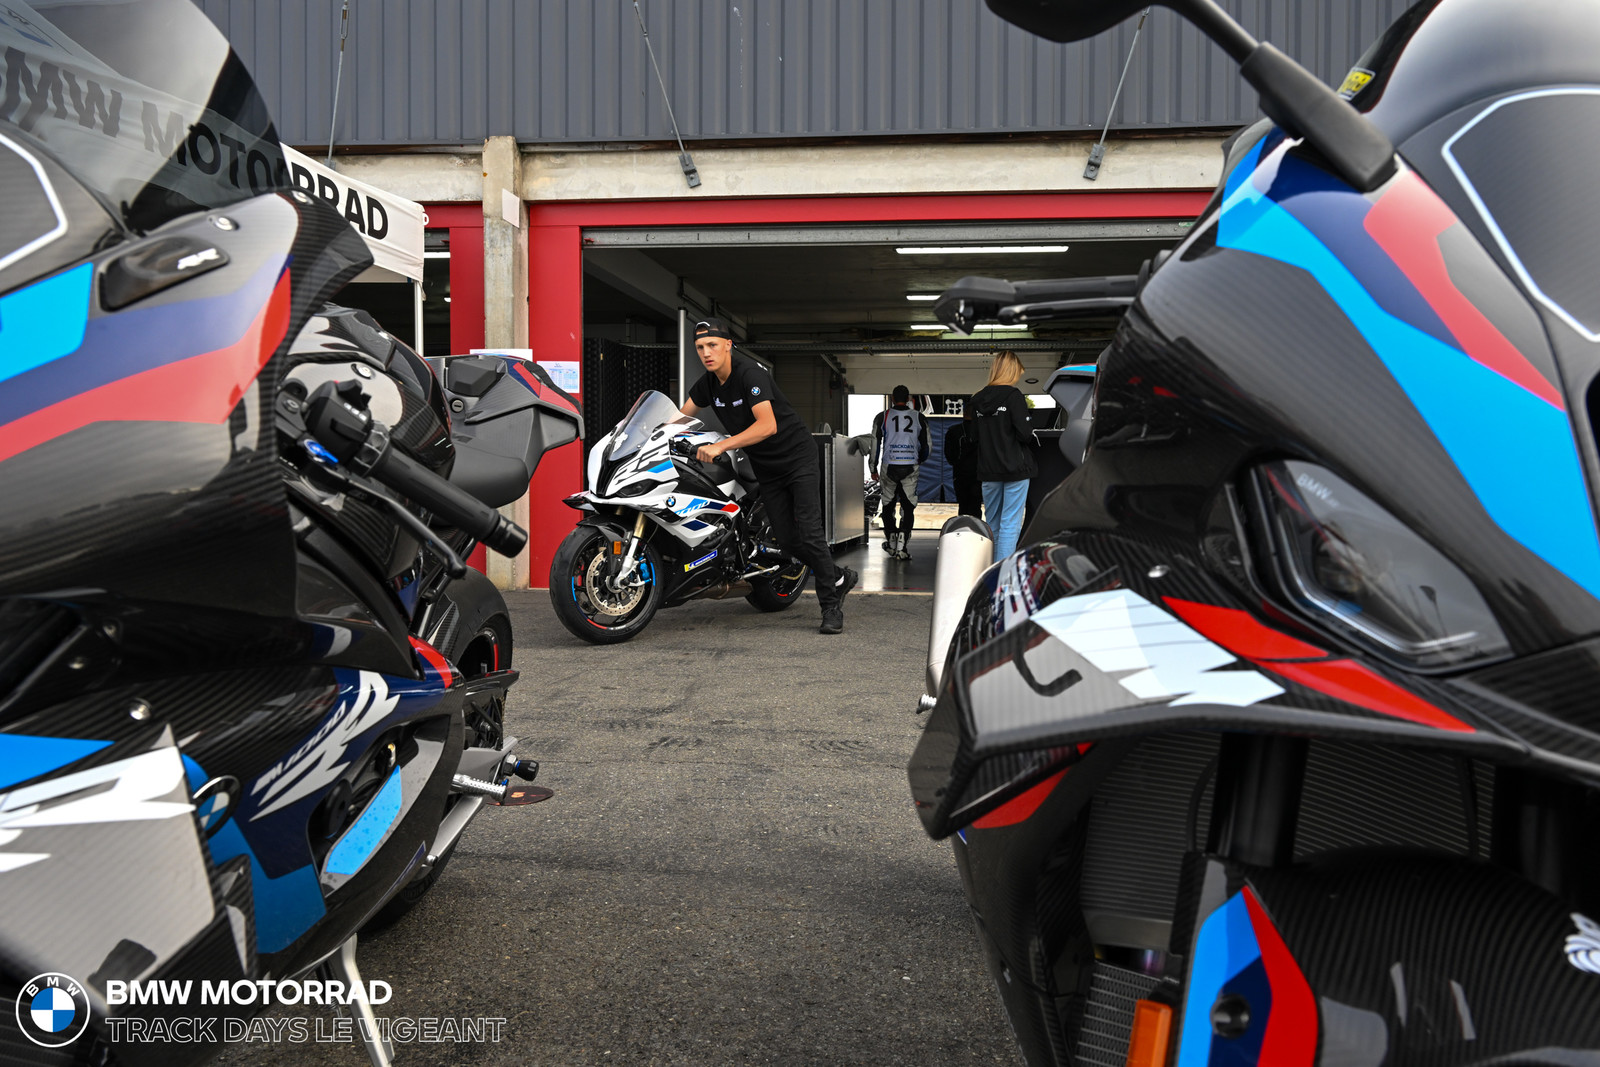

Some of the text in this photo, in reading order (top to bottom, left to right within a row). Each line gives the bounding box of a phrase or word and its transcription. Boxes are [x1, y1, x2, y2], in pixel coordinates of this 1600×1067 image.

[0, 46, 122, 138] MW
[891, 415, 914, 433] 12
[1297, 472, 1333, 500] BMW
